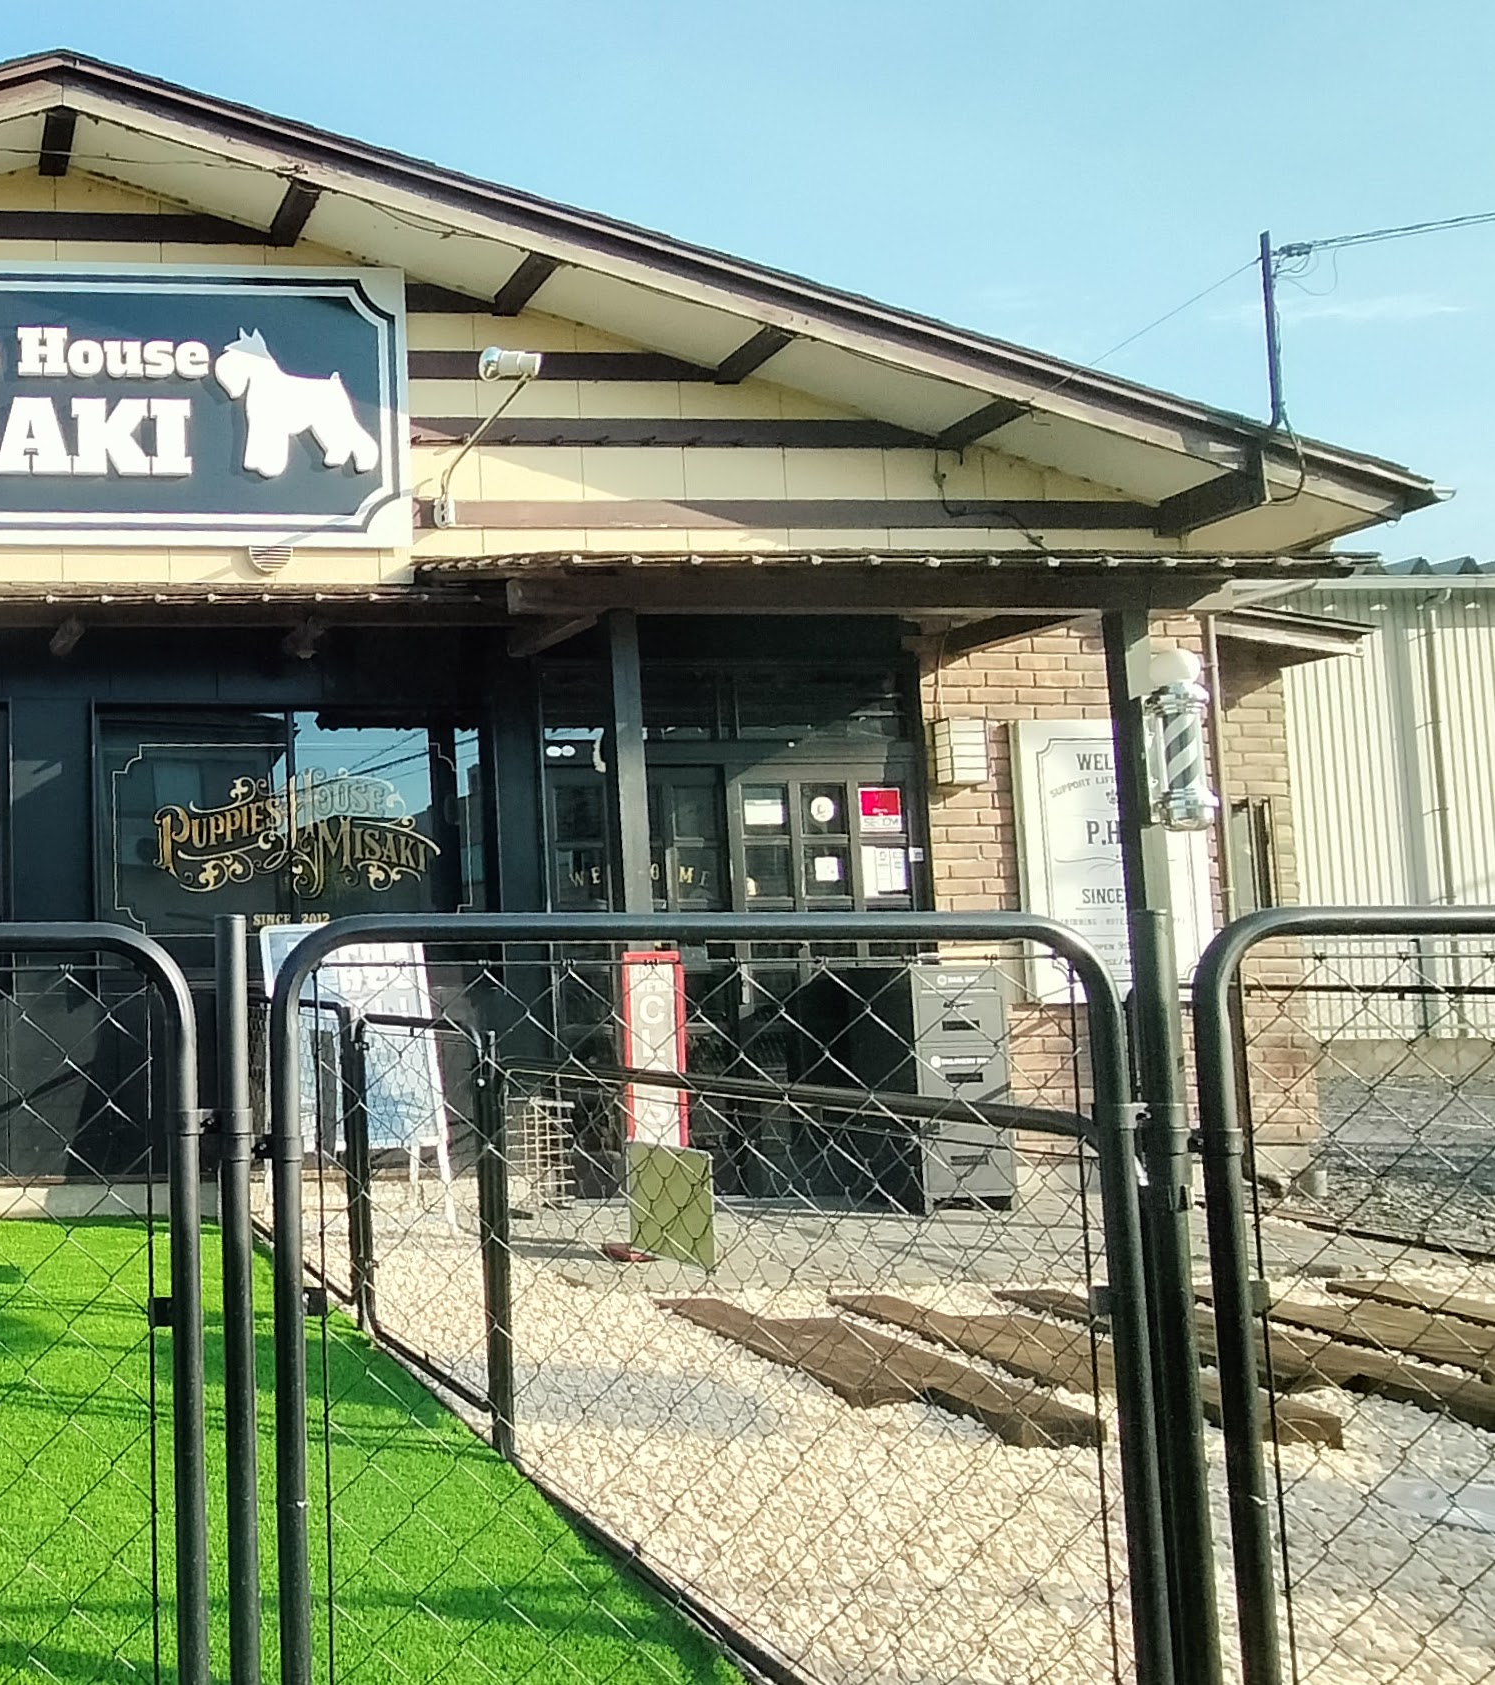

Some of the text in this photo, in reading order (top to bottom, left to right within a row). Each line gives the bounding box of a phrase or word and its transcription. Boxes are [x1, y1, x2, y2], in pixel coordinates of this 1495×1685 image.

[17, 325, 209, 379] House
[1076, 753, 1114, 771] WEL
[1049, 777, 1092, 798] SUPPORT
[153, 767, 389, 875] PUPPIES HOUSE
[1086, 820, 1123, 845] P.H
[313, 816, 429, 874] MISAKI
[1082, 888, 1126, 905] SINCE
[252, 913, 331, 926] SINCE 2012
